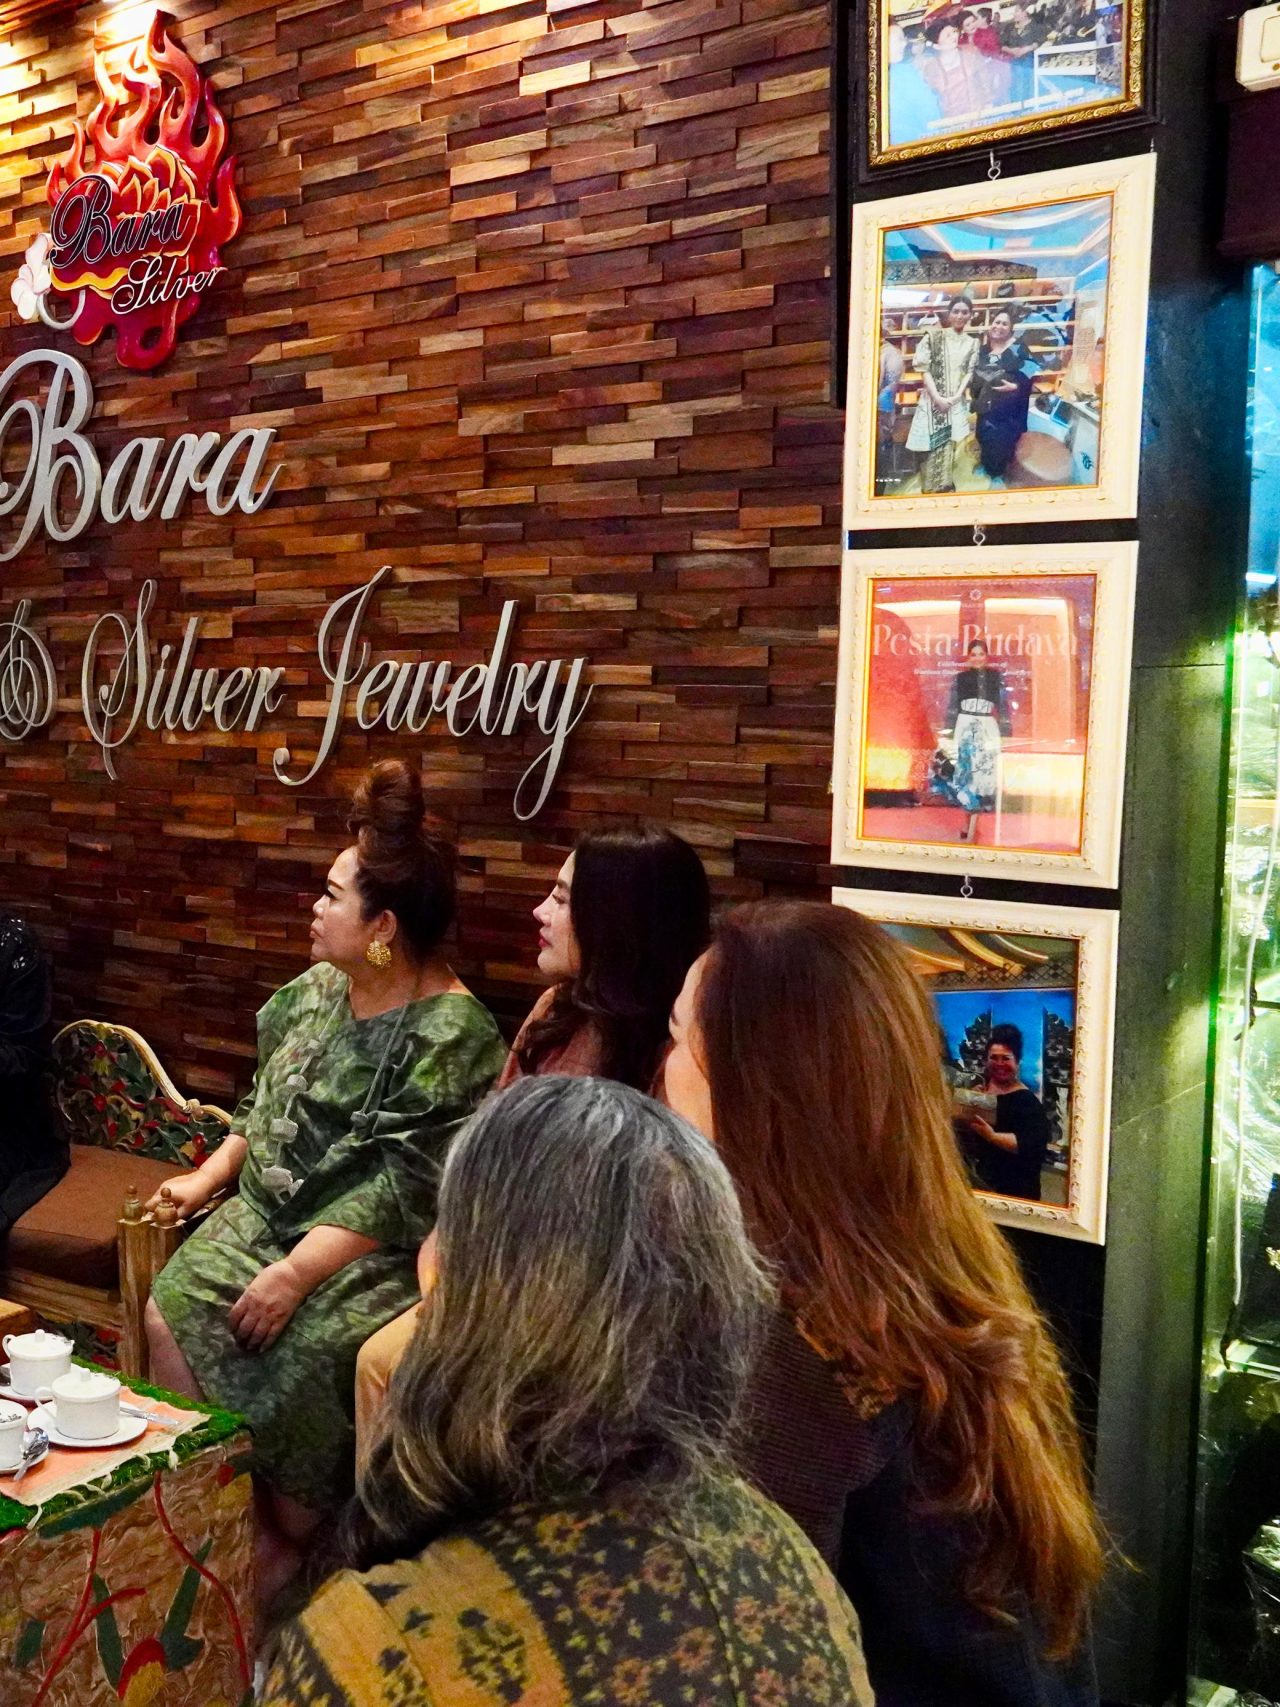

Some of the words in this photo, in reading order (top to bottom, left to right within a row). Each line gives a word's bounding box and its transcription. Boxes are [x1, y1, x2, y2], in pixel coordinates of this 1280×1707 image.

[49, 174, 193, 269] Bara
[111, 256, 228, 315] Silver
[874, 623, 952, 657] Pesta
[82, 579, 286, 780] Silver
[273, 565, 594, 822] Jewelry
